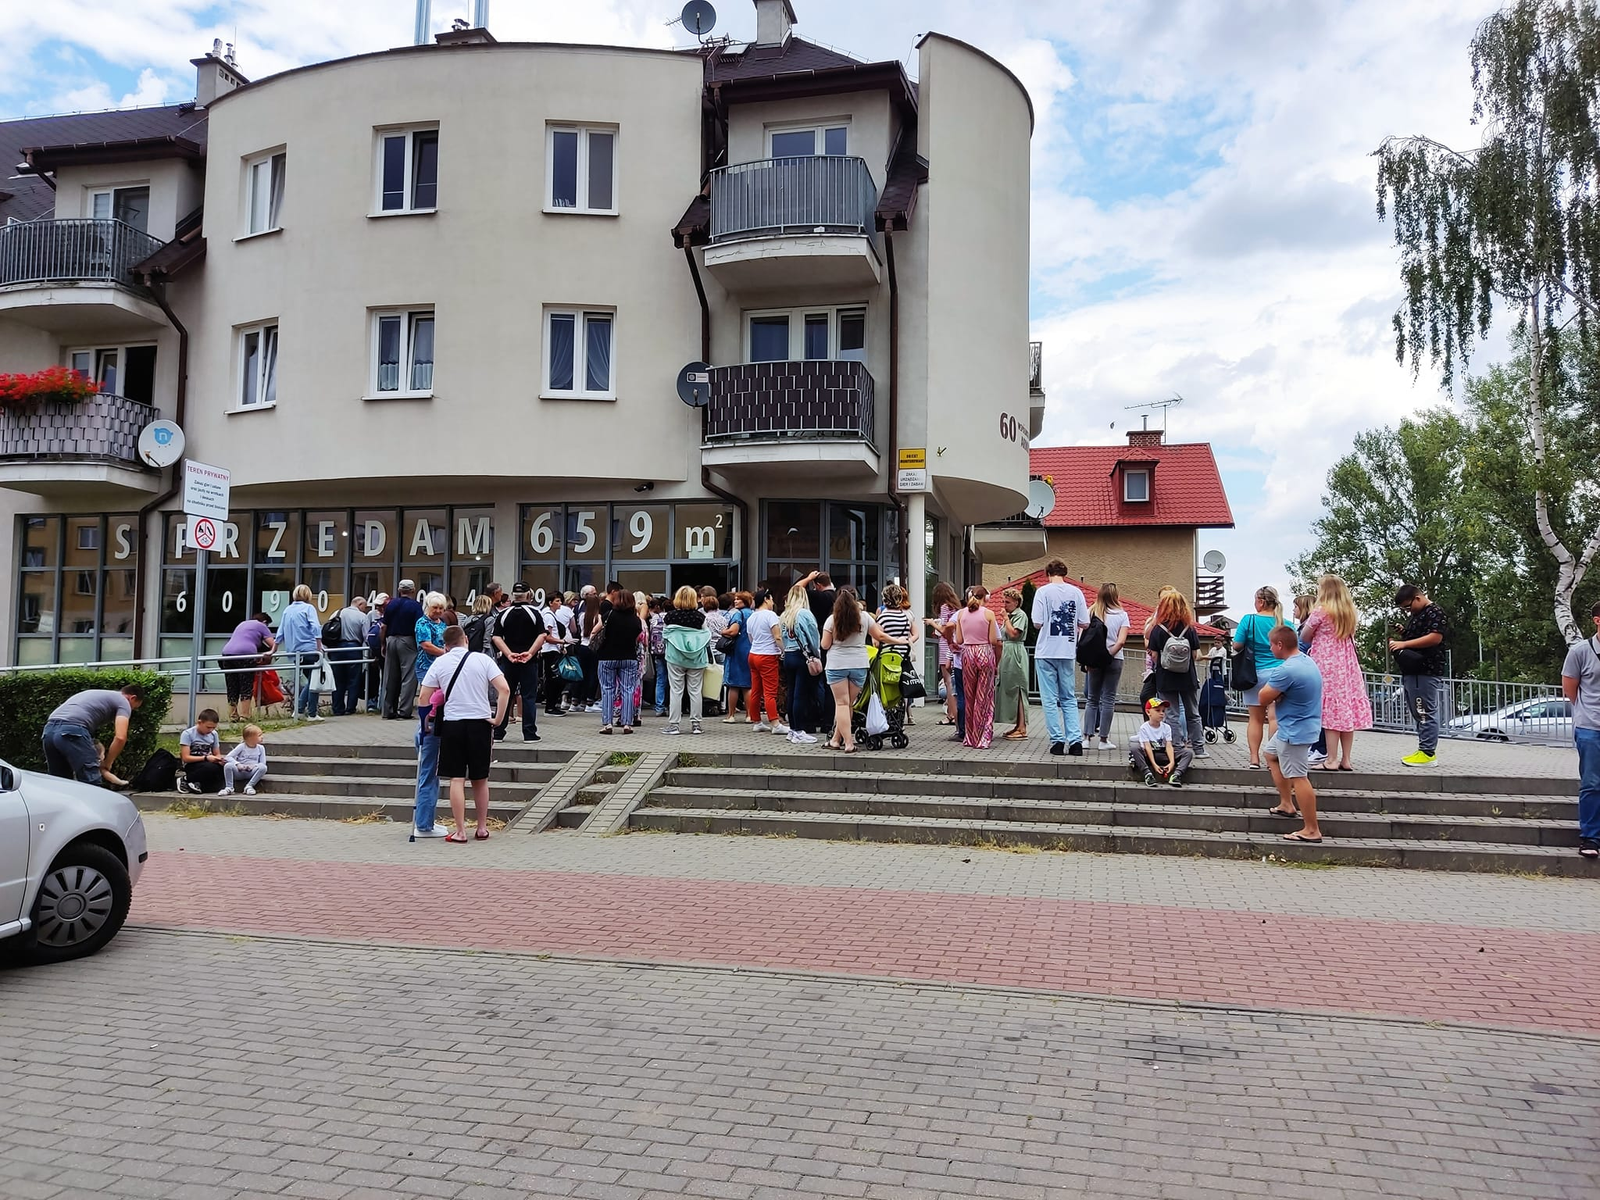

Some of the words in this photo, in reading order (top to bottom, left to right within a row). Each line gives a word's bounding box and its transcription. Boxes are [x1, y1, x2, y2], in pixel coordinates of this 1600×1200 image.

[999, 412, 1017, 443] 60
[187, 466, 203, 475] TEREN
[204, 470, 229, 481] PRYWATNY
[530, 510, 653, 554] 659
